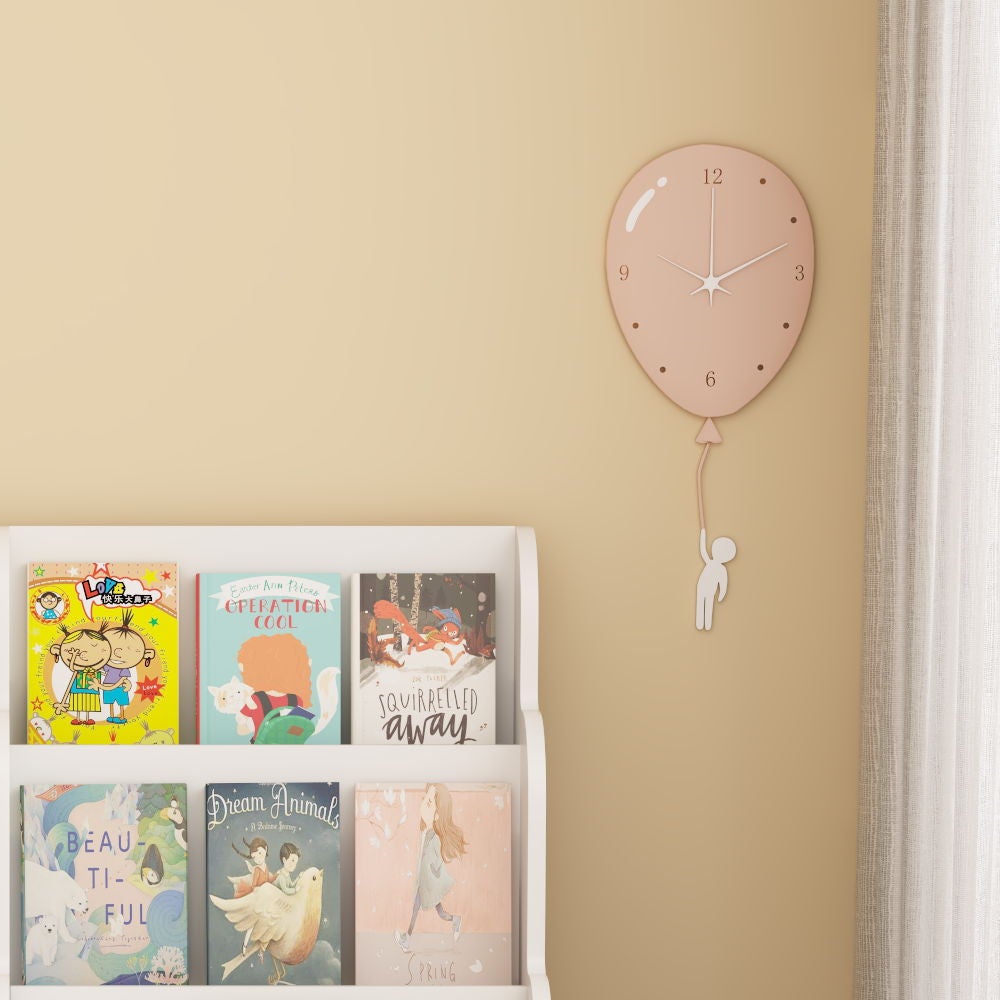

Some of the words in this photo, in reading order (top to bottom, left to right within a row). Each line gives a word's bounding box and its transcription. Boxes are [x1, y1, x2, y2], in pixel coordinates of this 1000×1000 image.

[703, 168, 723, 185] 12
[619, 265, 629, 281] 9
[795, 265, 805, 281] 3
[705, 371, 716, 387] 6
[225, 598, 327, 613] OPERATION
[254, 615, 298, 629] COOL
[378, 687, 478, 718] SQUIRRELLED
[382, 712, 477, 744] away
[207, 788, 267, 830] Dream
[270, 783, 339, 829] Animals
[105, 903, 147, 925] FUL
[405, 951, 456, 985] SPRING
